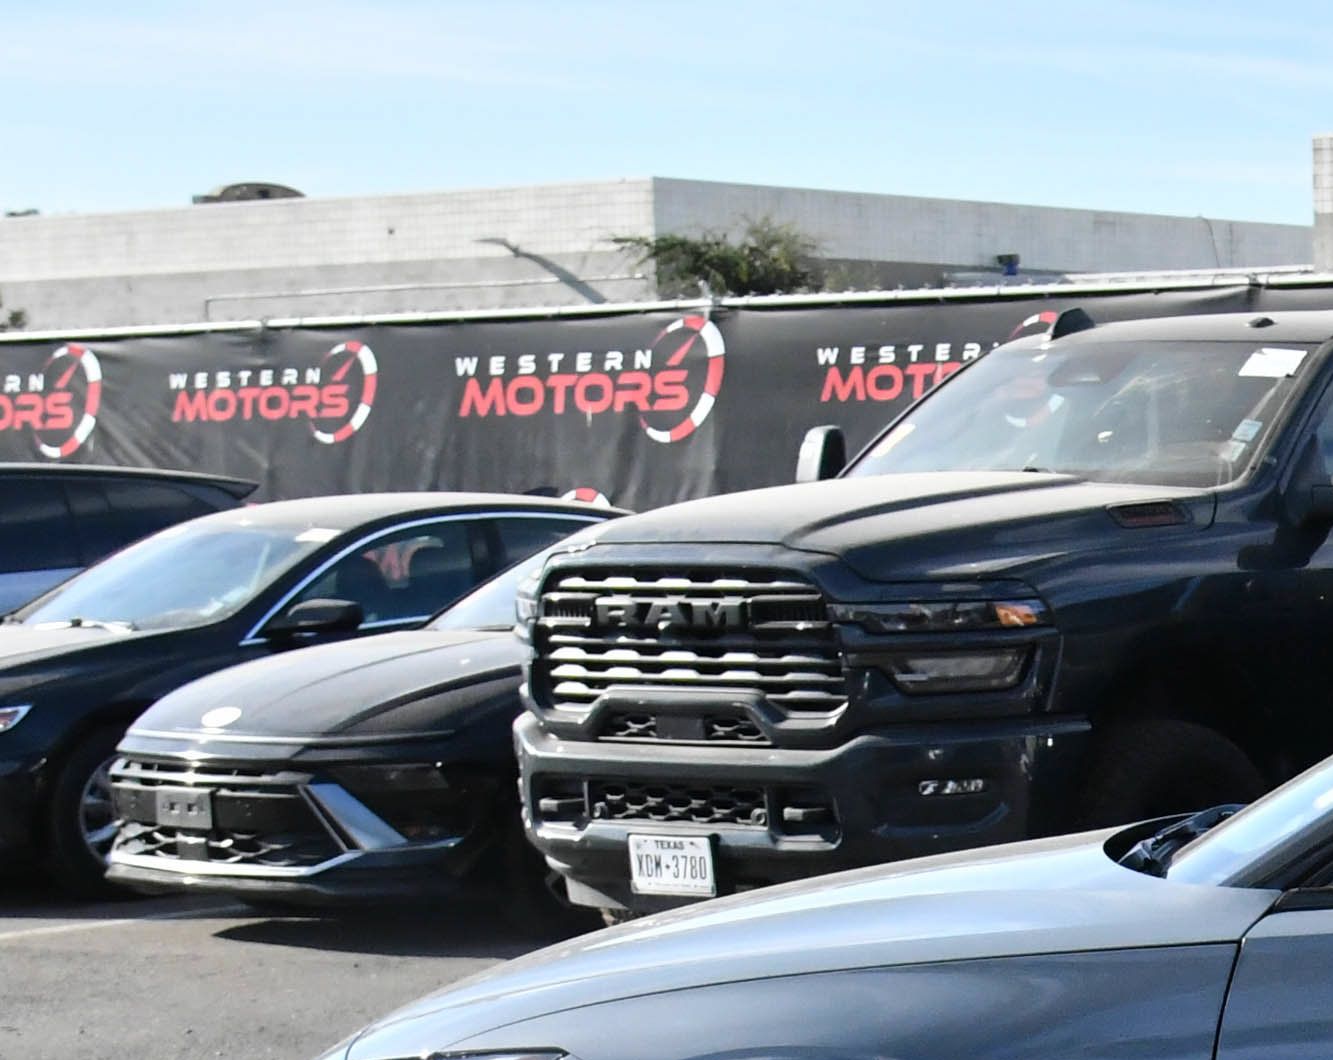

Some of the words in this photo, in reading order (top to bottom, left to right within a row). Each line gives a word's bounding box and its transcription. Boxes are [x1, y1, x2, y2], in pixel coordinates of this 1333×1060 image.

[456, 349, 653, 376] WESTERN
[816, 342, 999, 366] WESTER
[168, 366, 321, 390] WESTERN
[172, 384, 350, 423] MOTORS
[459, 370, 690, 418] MOTORS
[596, 597, 747, 627] RAM
[655, 840, 685, 850] TEXAS
